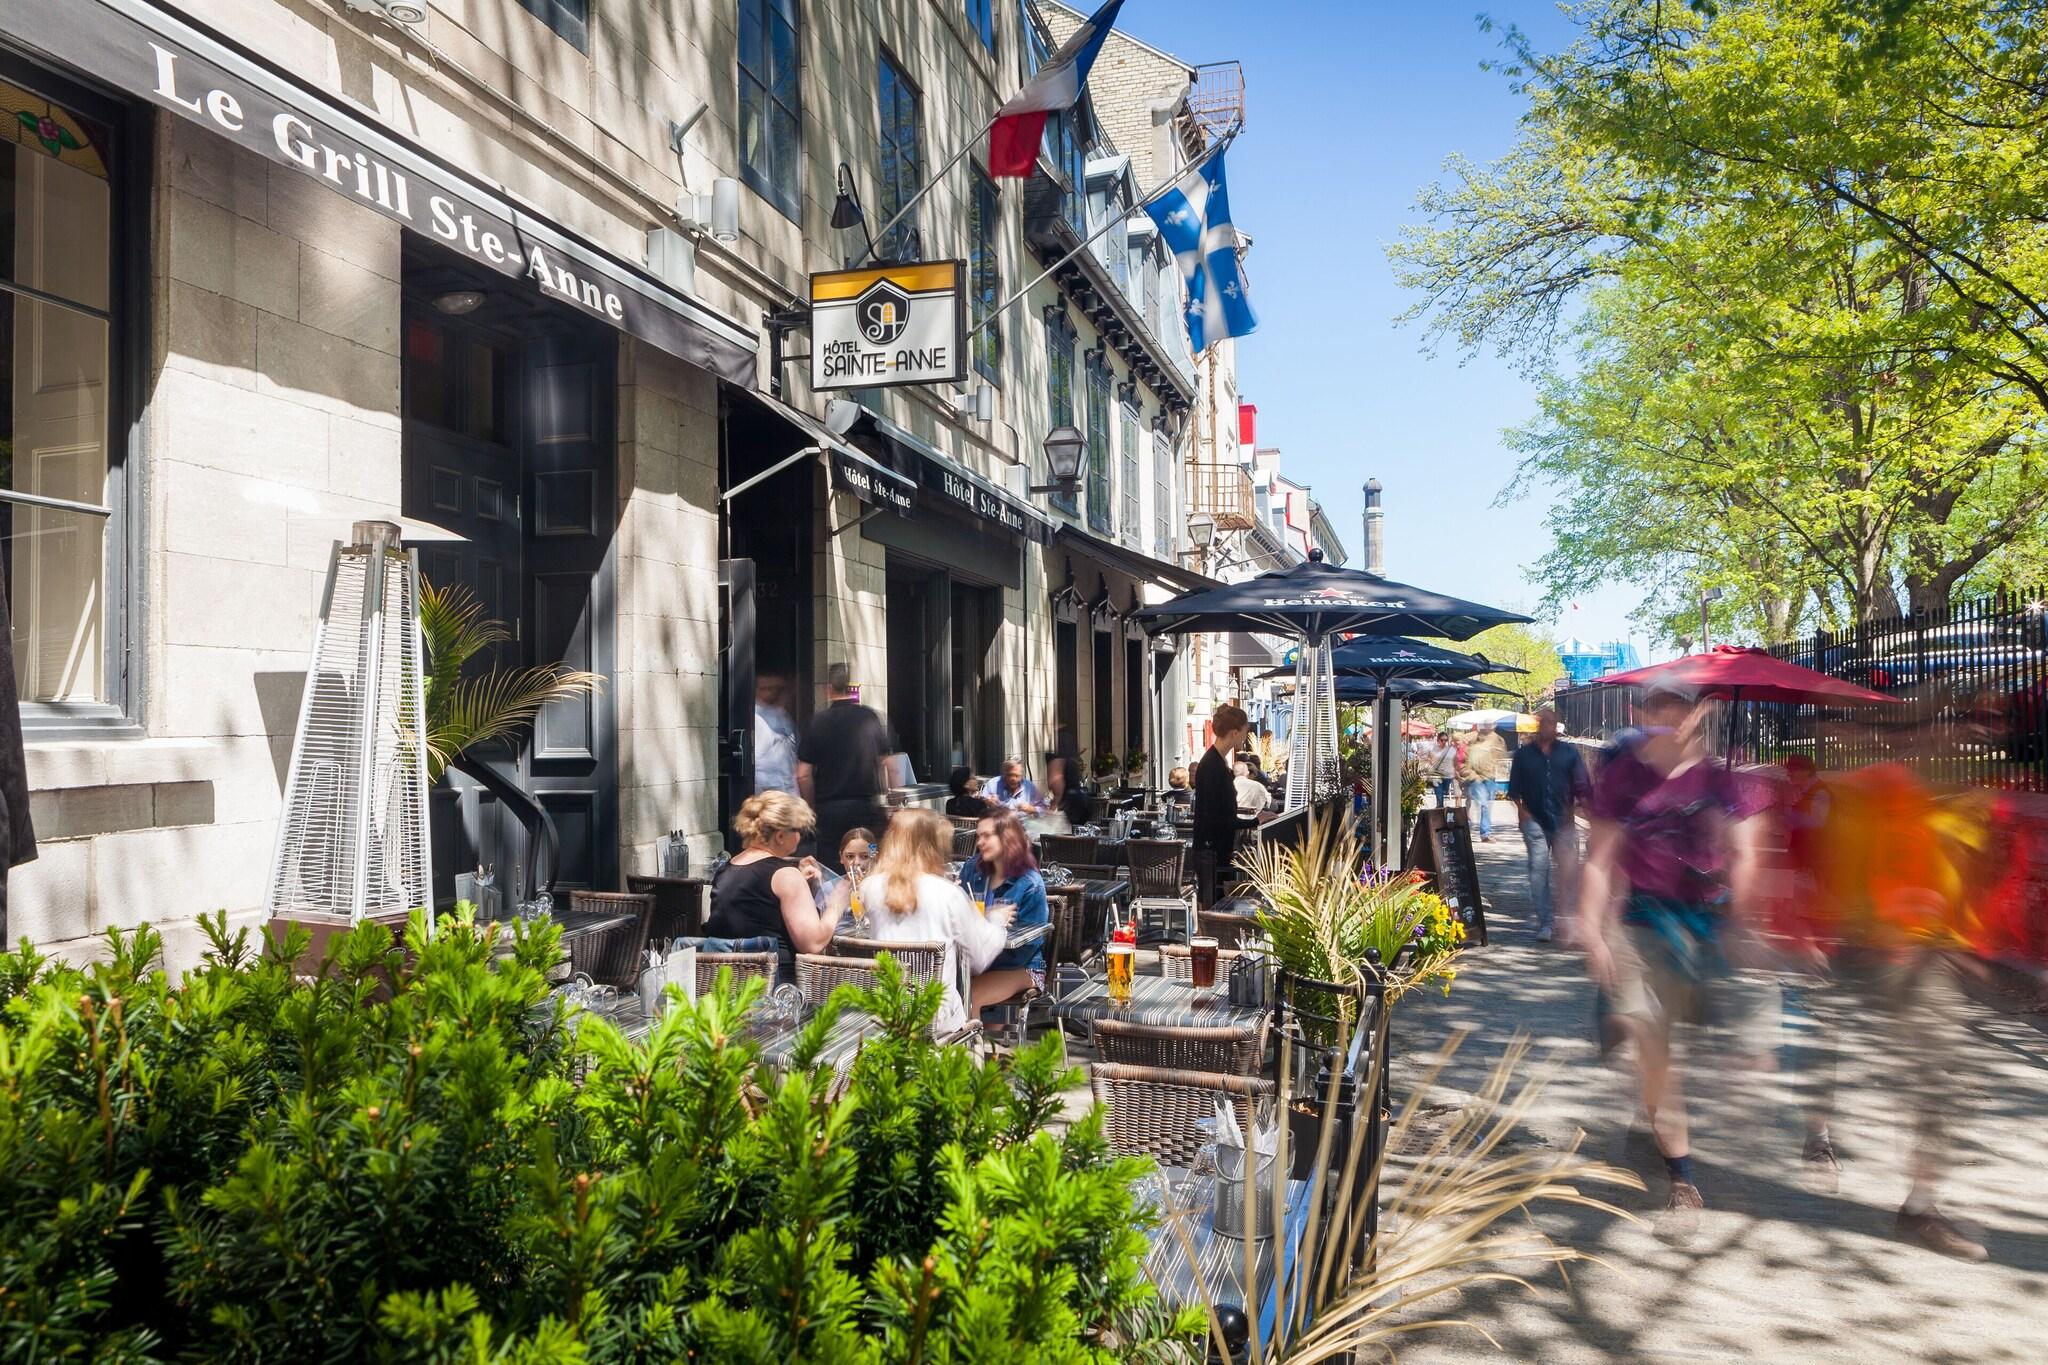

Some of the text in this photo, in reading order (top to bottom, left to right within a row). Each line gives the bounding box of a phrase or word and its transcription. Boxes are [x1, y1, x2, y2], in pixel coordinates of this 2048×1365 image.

[148, 41, 623, 321] Le Grill Ste-Anne
[823, 340, 861, 356] HÔTEL
[823, 347, 946, 377] SAINTE-ANNE
[843, 466, 911, 508] Hôtel Ste-Anne
[943, 472, 1023, 530] Hôtel Ste-Anne
[1263, 598, 1407, 609] Heineken
[1368, 656, 1453, 665] Heineken
